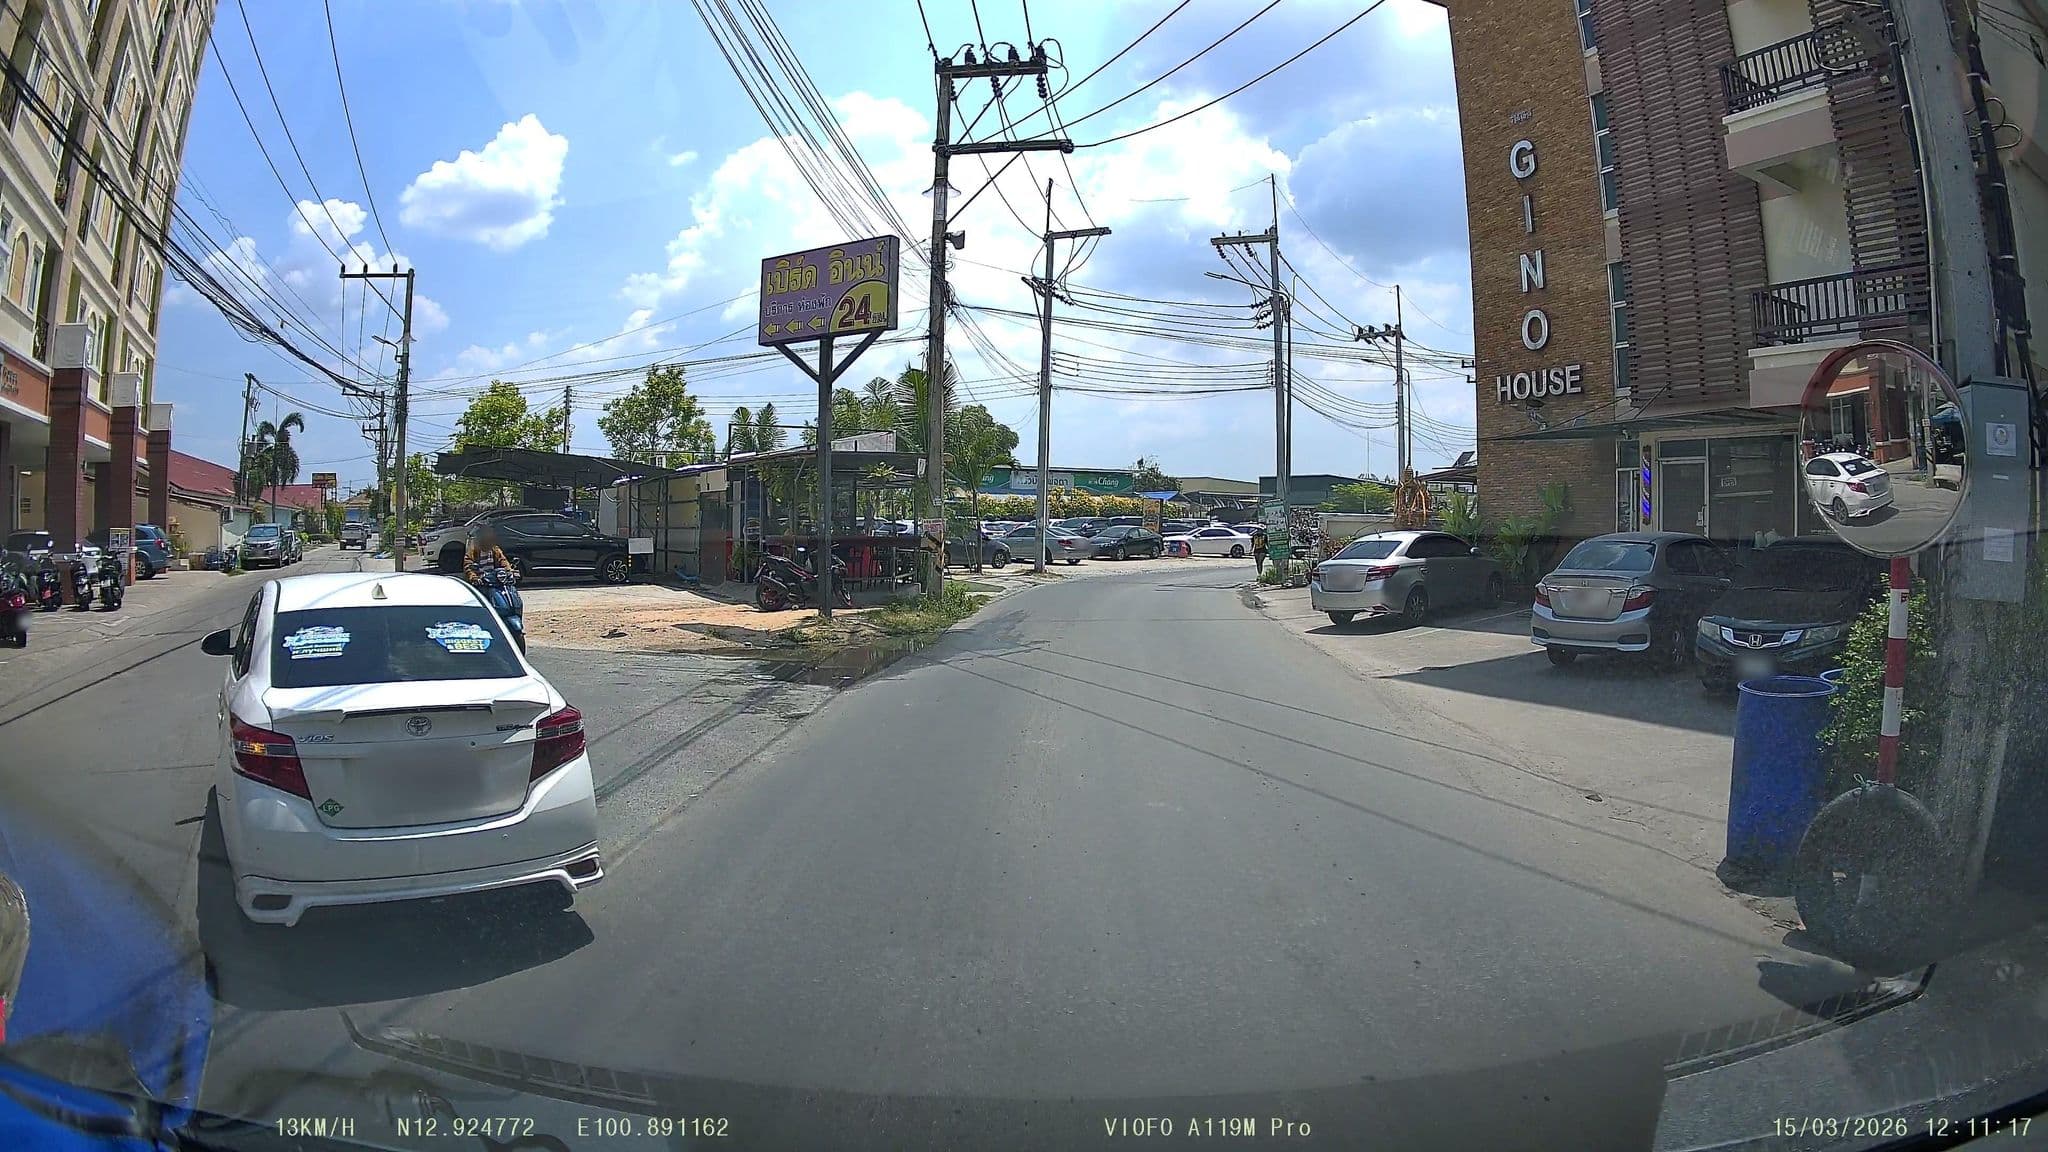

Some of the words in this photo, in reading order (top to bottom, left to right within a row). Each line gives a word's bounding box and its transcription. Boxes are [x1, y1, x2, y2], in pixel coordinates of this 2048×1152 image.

[1508, 138, 1551, 351] GINO
[838, 293, 872, 329] 24
[1495, 363, 1583, 403] HOUSE
[1098, 476, 1120, 488] Chang
[322, 804, 340, 812] LPG
